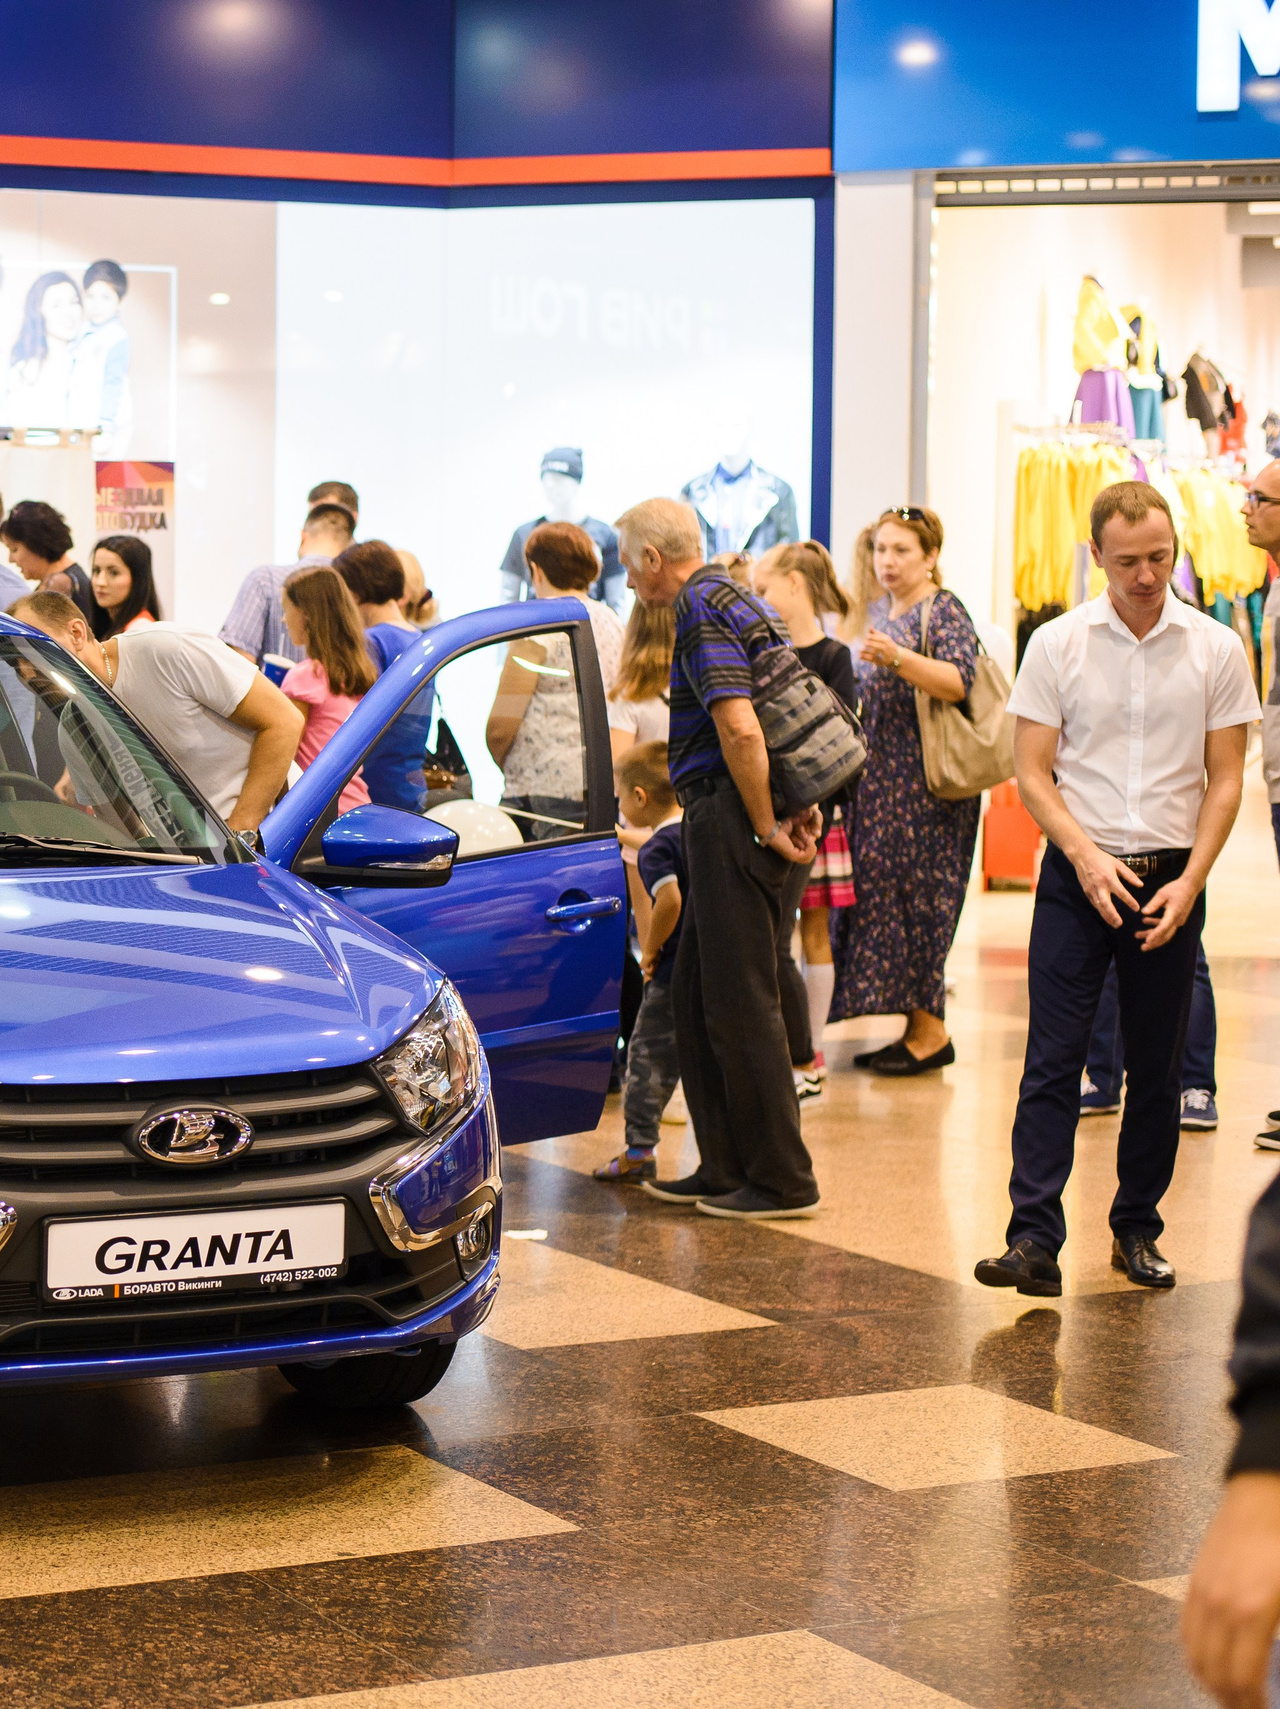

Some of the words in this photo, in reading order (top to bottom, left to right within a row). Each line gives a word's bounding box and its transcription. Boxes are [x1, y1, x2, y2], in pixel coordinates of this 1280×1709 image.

[94, 1228, 294, 1276] GRANTA
[260, 1270, 293, 1285] (4742)
[294, 1267, 338, 1281] 522-002
[78, 1287, 104, 1298] LADA
[123, 1282, 176, 1296] БОРАВТО
[177, 1280, 223, 1291] Викинги
